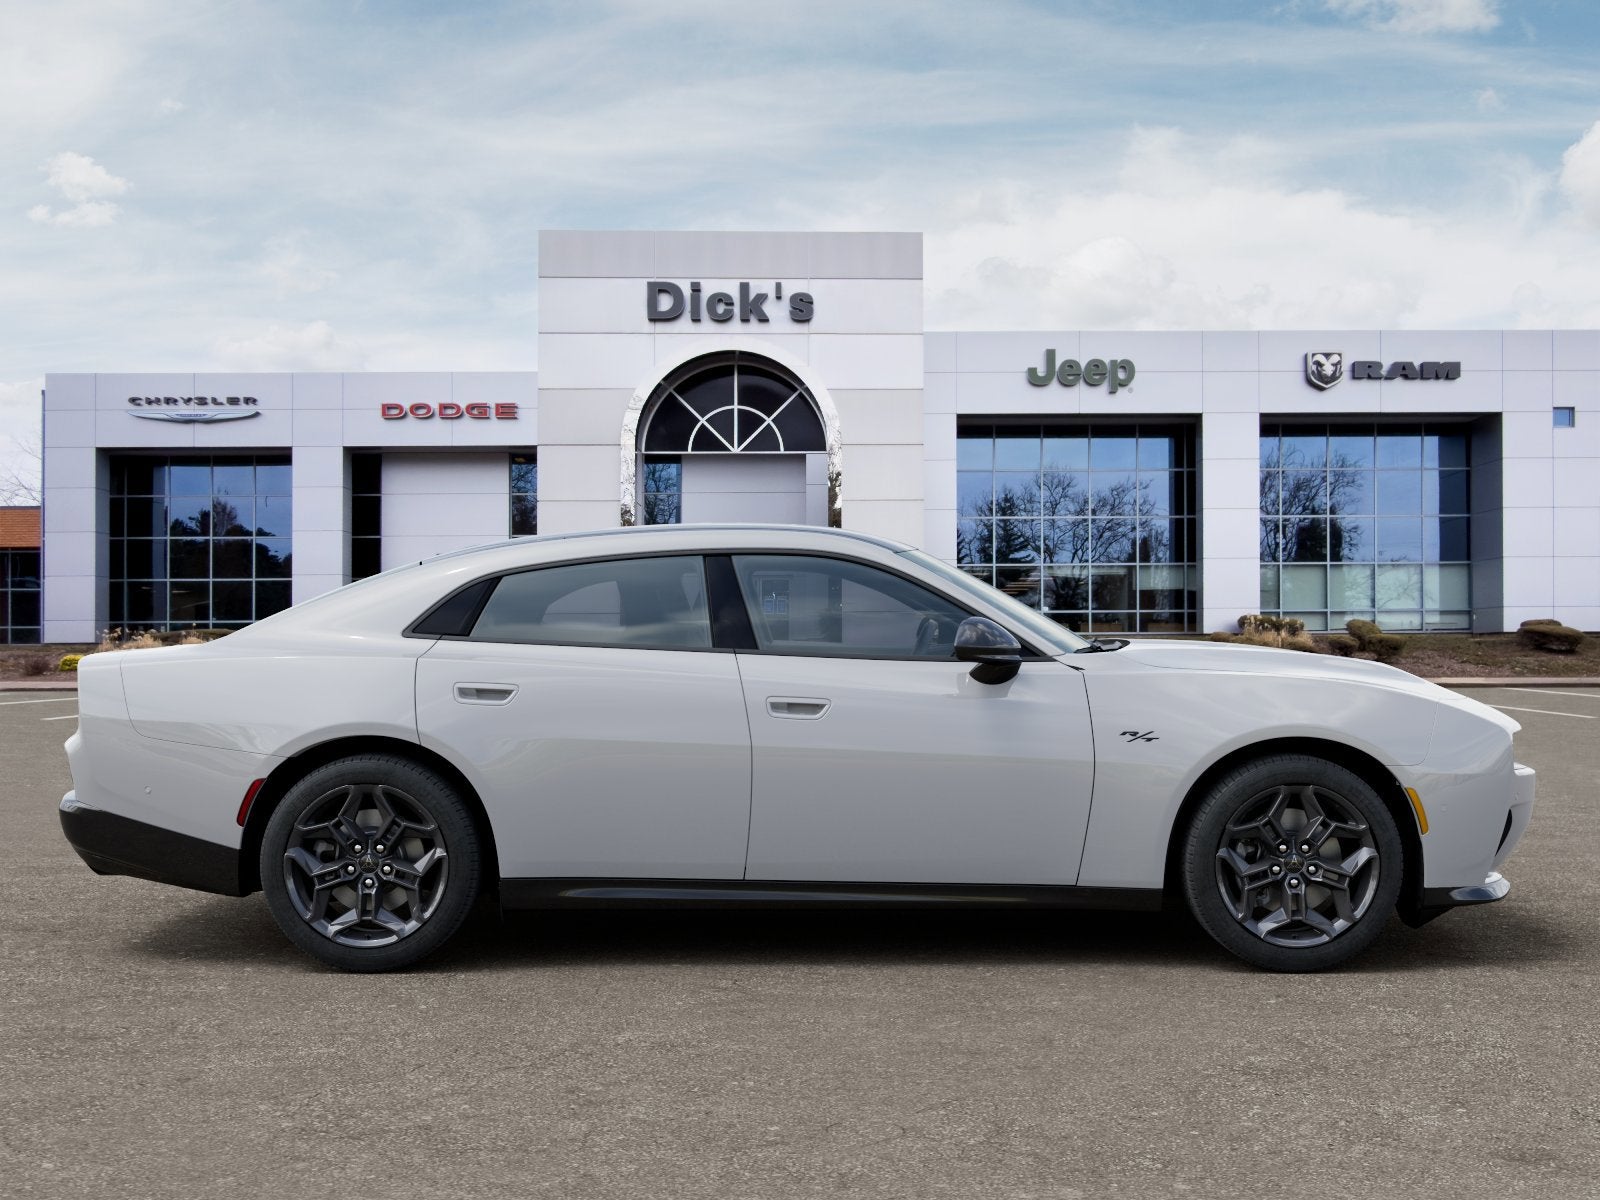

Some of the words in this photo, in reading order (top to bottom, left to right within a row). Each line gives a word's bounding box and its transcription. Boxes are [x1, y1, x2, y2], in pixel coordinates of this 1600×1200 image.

[647, 281, 814, 323] Dick's
[1027, 348, 1136, 394] Jeep
[1352, 360, 1461, 380] RAM
[128, 396, 258, 407] CHRYSLER
[381, 402, 518, 420] DODGE
[1119, 730, 1160, 742] R/T
